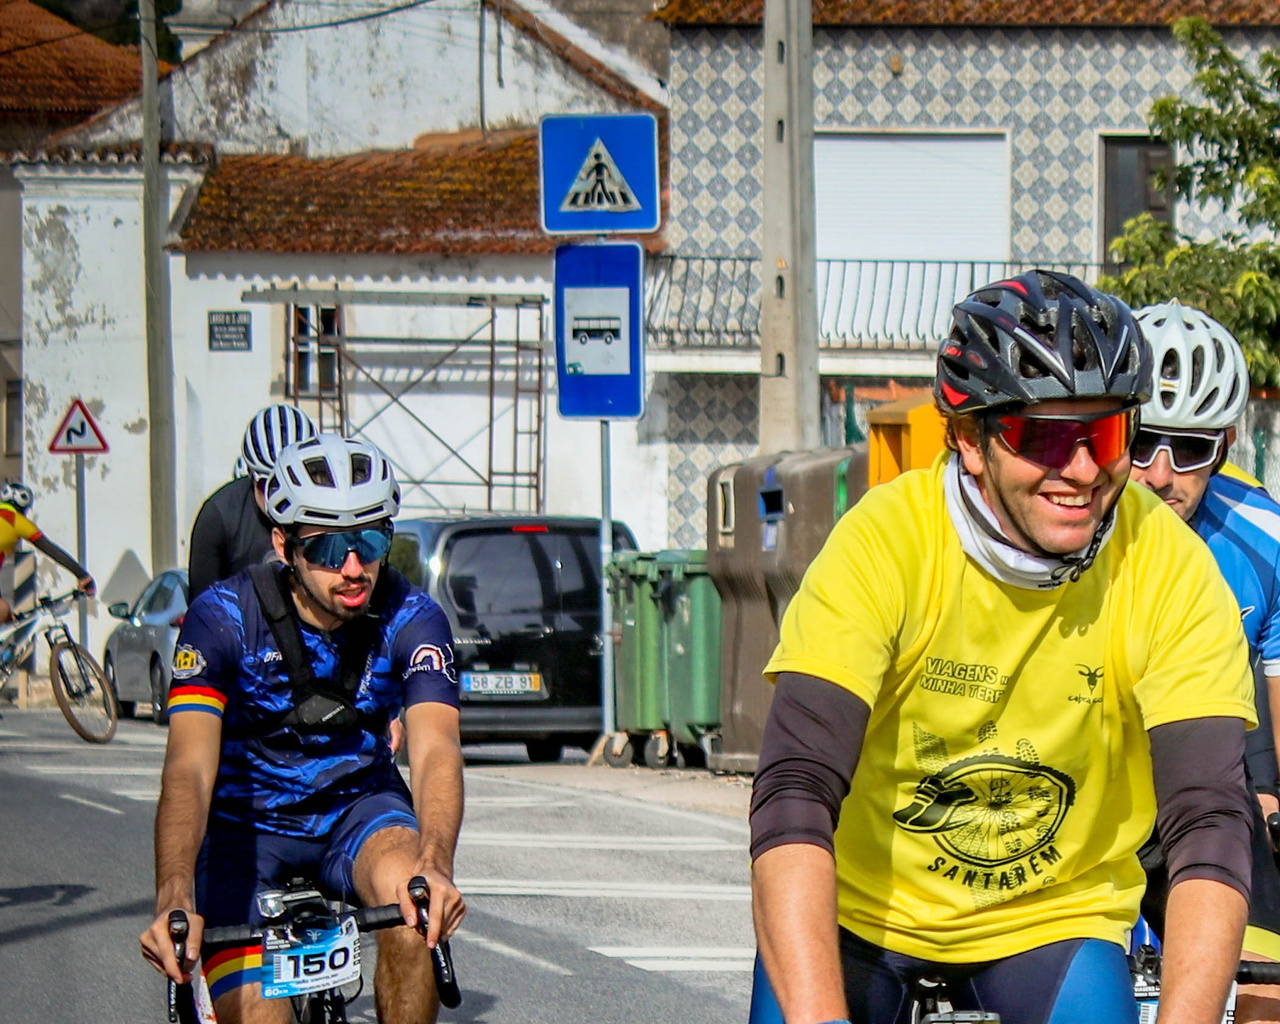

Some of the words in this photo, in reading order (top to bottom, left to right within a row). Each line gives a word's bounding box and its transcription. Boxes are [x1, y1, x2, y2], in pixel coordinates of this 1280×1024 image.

[926, 657, 998, 684] VIAGENS
[920, 675, 966, 696] MINHA
[287, 947, 349, 979] 150
